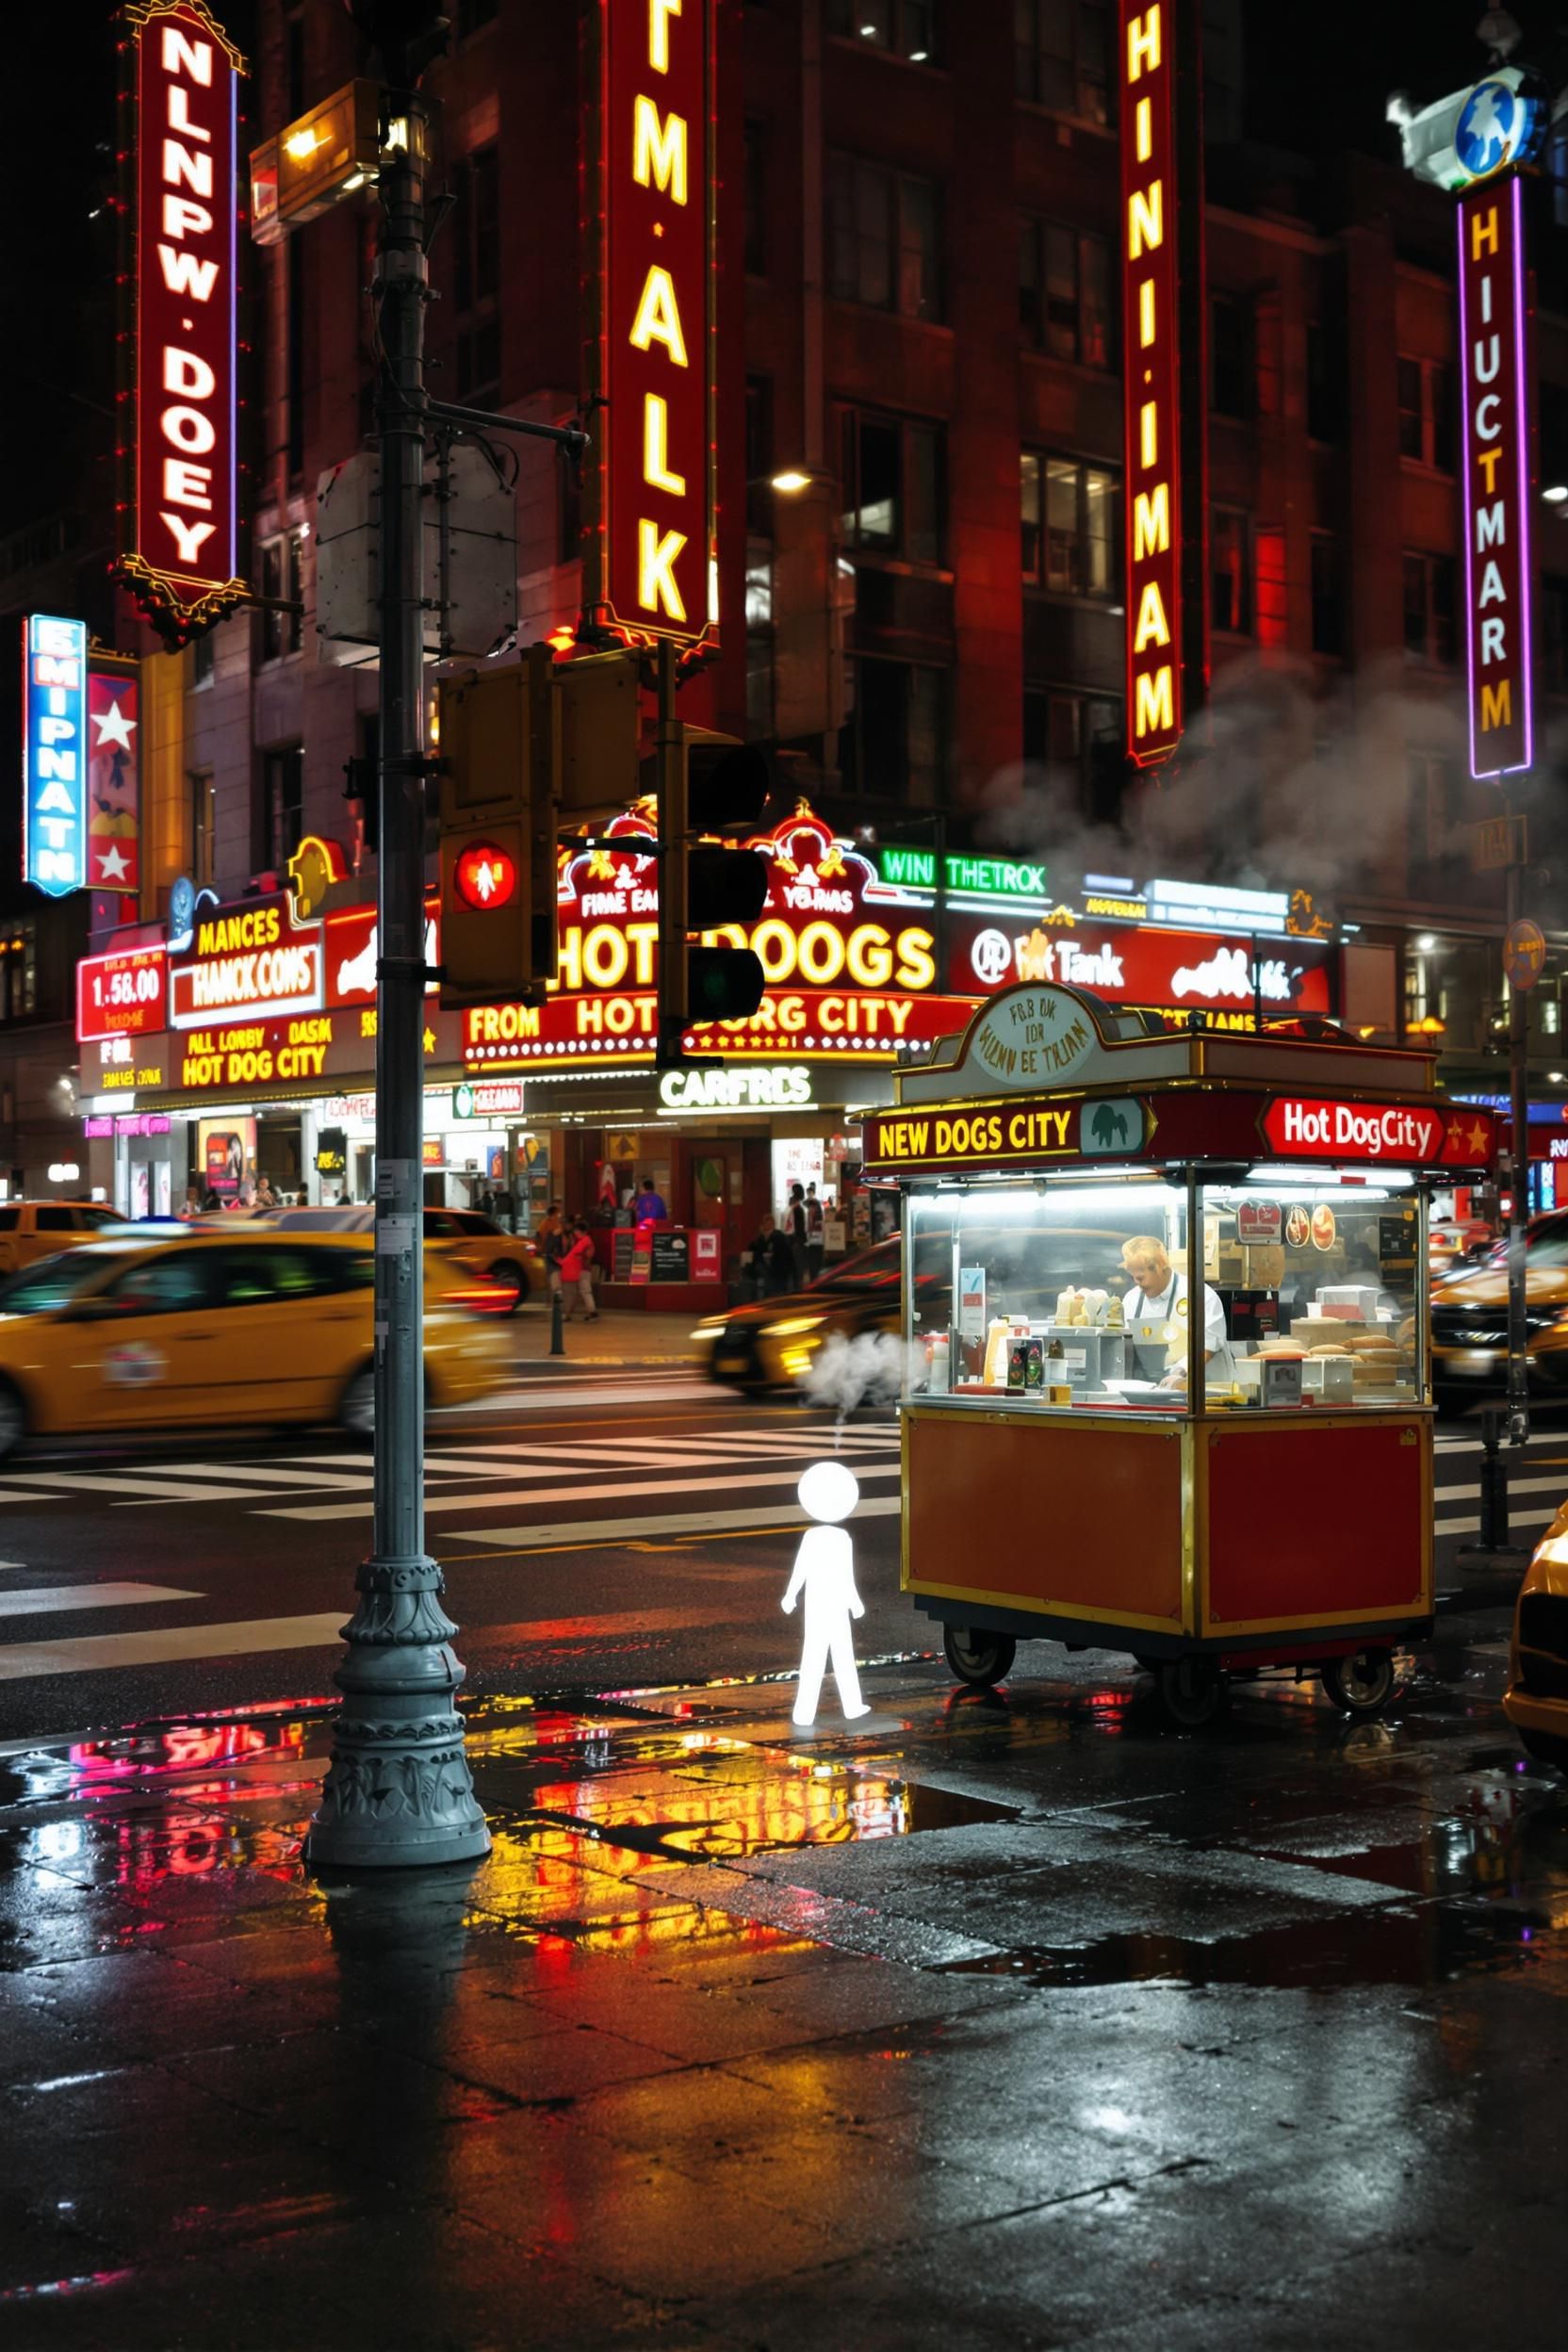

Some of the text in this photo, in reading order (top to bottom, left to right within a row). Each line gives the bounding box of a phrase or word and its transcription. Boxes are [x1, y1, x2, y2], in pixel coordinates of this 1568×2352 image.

[159, 345, 217, 564] DOEY
[197, 907, 280, 956] MANCES
[469, 1005, 540, 1042] FROM
[577, 997, 658, 1034] HOT
[818, 997, 913, 1034] CITY
[183, 1054, 224, 1086] HOT
[228, 1050, 273, 1083] DOG
[276, 1045, 326, 1078] CITY
[878, 1110, 1071, 1158] NEW DOGS CITY
[1283, 1102, 1329, 1143] Hot
